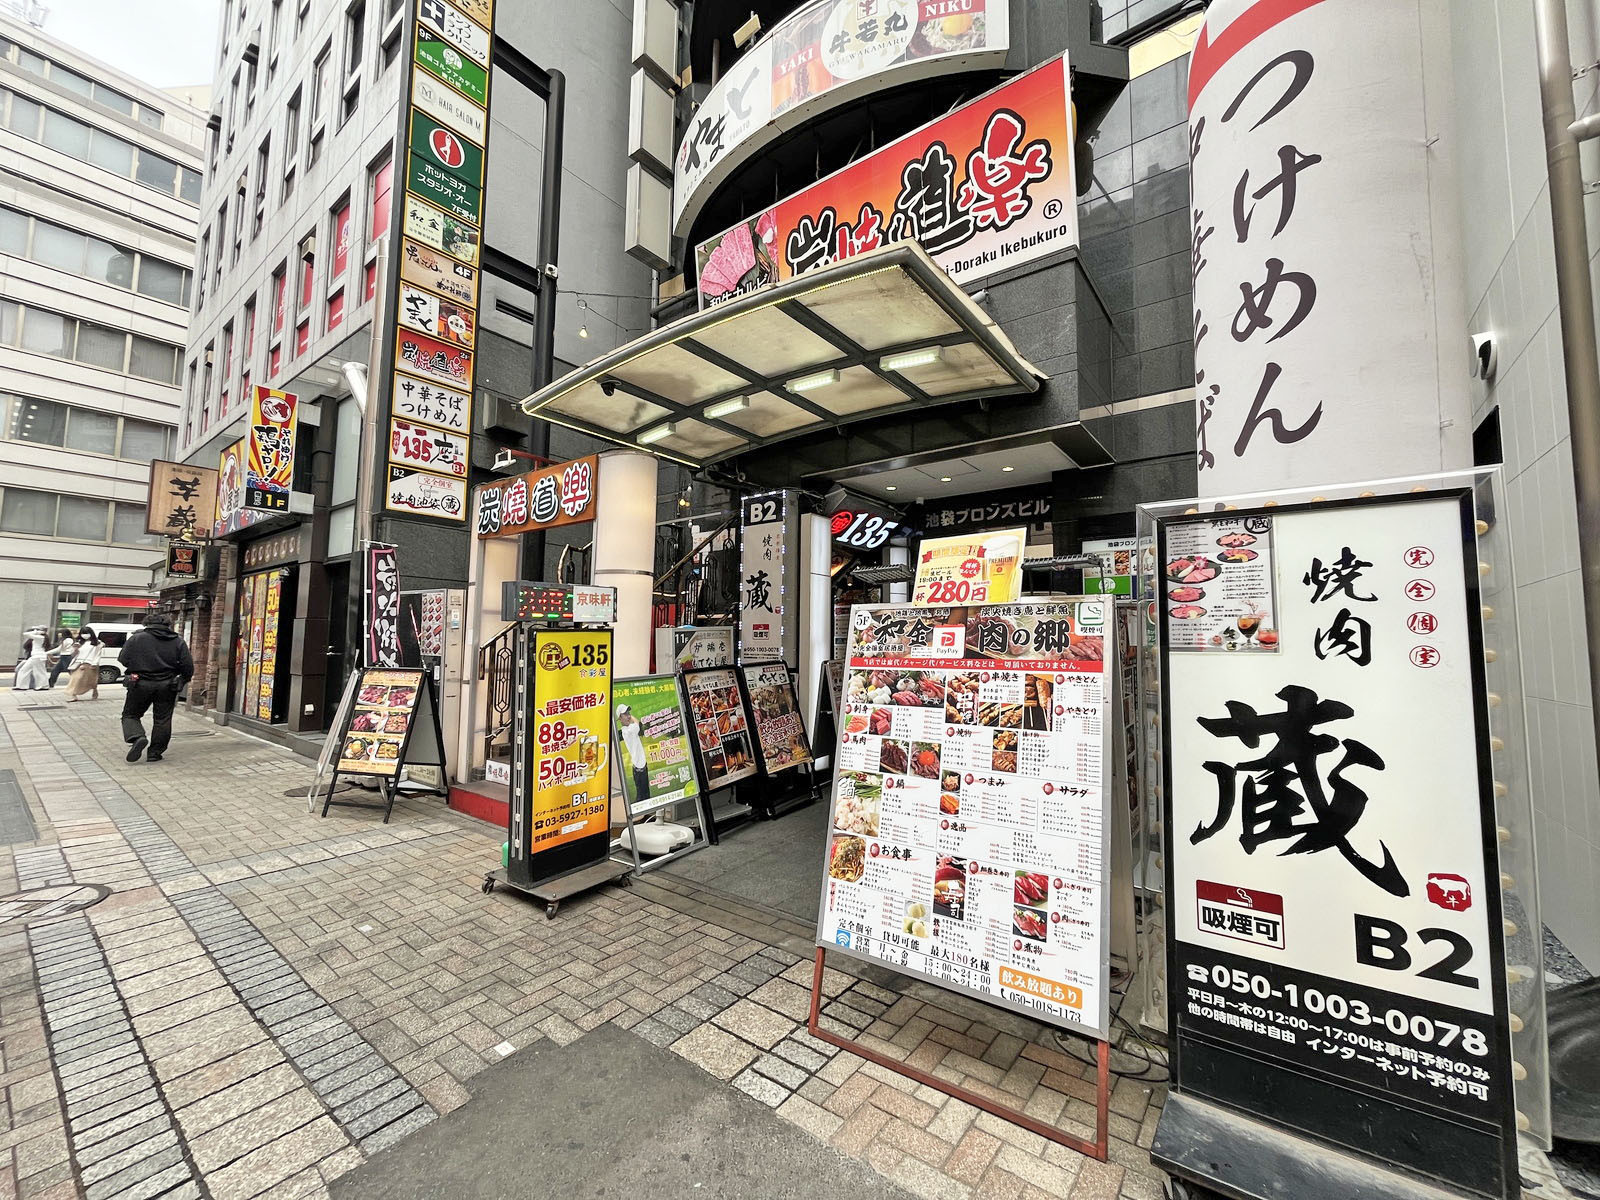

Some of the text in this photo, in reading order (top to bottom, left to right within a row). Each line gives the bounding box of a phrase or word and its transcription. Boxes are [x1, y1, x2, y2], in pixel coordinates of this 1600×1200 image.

[924, 0, 973, 17] NIKU
[448, 11, 472, 31] メンズ
[448, 19, 471, 39] ライフ
[829, 10, 909, 55] 牛若丸
[419, 28, 432, 40] 9F
[447, 29, 486, 59] クリニック
[779, 51, 814, 75] YAKI
[438, 96, 482, 132] HAIR SALON M
[417, 172, 472, 206] スタジオ・オー
[424, 163, 467, 193] ホットヨガ
[451, 203, 478, 223] 7F受付
[1000, 223, 1067, 257] Ikebukuro
[1221, 49, 1322, 457] つけめん
[455, 266, 471, 278] 4F
[405, 293, 433, 332] やまと
[402, 381, 463, 411] 中華そば
[401, 401, 463, 428] つけめん
[393, 468, 405, 478] B2
[453, 464, 464, 474] B1
[266, 494, 285, 508] 1F
[750, 500, 777, 523] B2
[925, 500, 1051, 528] 池袋ブロンズビル
[836, 512, 899, 549] 135
[576, 592, 612, 607] 京味軒
[743, 569, 774, 614] 蔵
[927, 580, 987, 604] 280円
[1302, 546, 1379, 667] 焼肉
[1406, 547, 1438, 667] 完全個室
[856, 614, 870, 626] 5F
[873, 614, 932, 647] 和金
[978, 619, 1071, 654] 肉の郷
[571, 644, 608, 667] 135
[991, 672, 1019, 682] 串焼き
[1066, 675, 1098, 684] やきとん
[853, 704, 869, 714] 刺身
[1066, 706, 1097, 715] やきとり
[541, 739, 568, 755] 串焼き
[538, 770, 579, 792] ハイボール
[978, 777, 1005, 787] つまみ
[1059, 785, 1089, 798] サラダ
[1188, 684, 1411, 898] 蔵
[571, 792, 588, 807] B1
[545, 803, 605, 828] 03-5927-1380
[881, 844, 912, 862] お食事
[1063, 882, 1092, 894] にぎり寿司
[1445, 896, 1459, 908] 牛
[838, 917, 873, 937] 完全個室
[1202, 906, 1280, 942] 吸煙可
[882, 930, 920, 951] 貸切可能
[1023, 942, 1043, 955] 煮物
[1353, 913, 1480, 990] B2
[1001, 969, 1077, 1004] 飲み放題あり
[1009, 991, 1081, 1023] 050-1018-1173
[1211, 964, 1489, 1056] 050-1003-0078
[1187, 1001, 1489, 1101] 他の時間帯は自由 インターネット予約可
